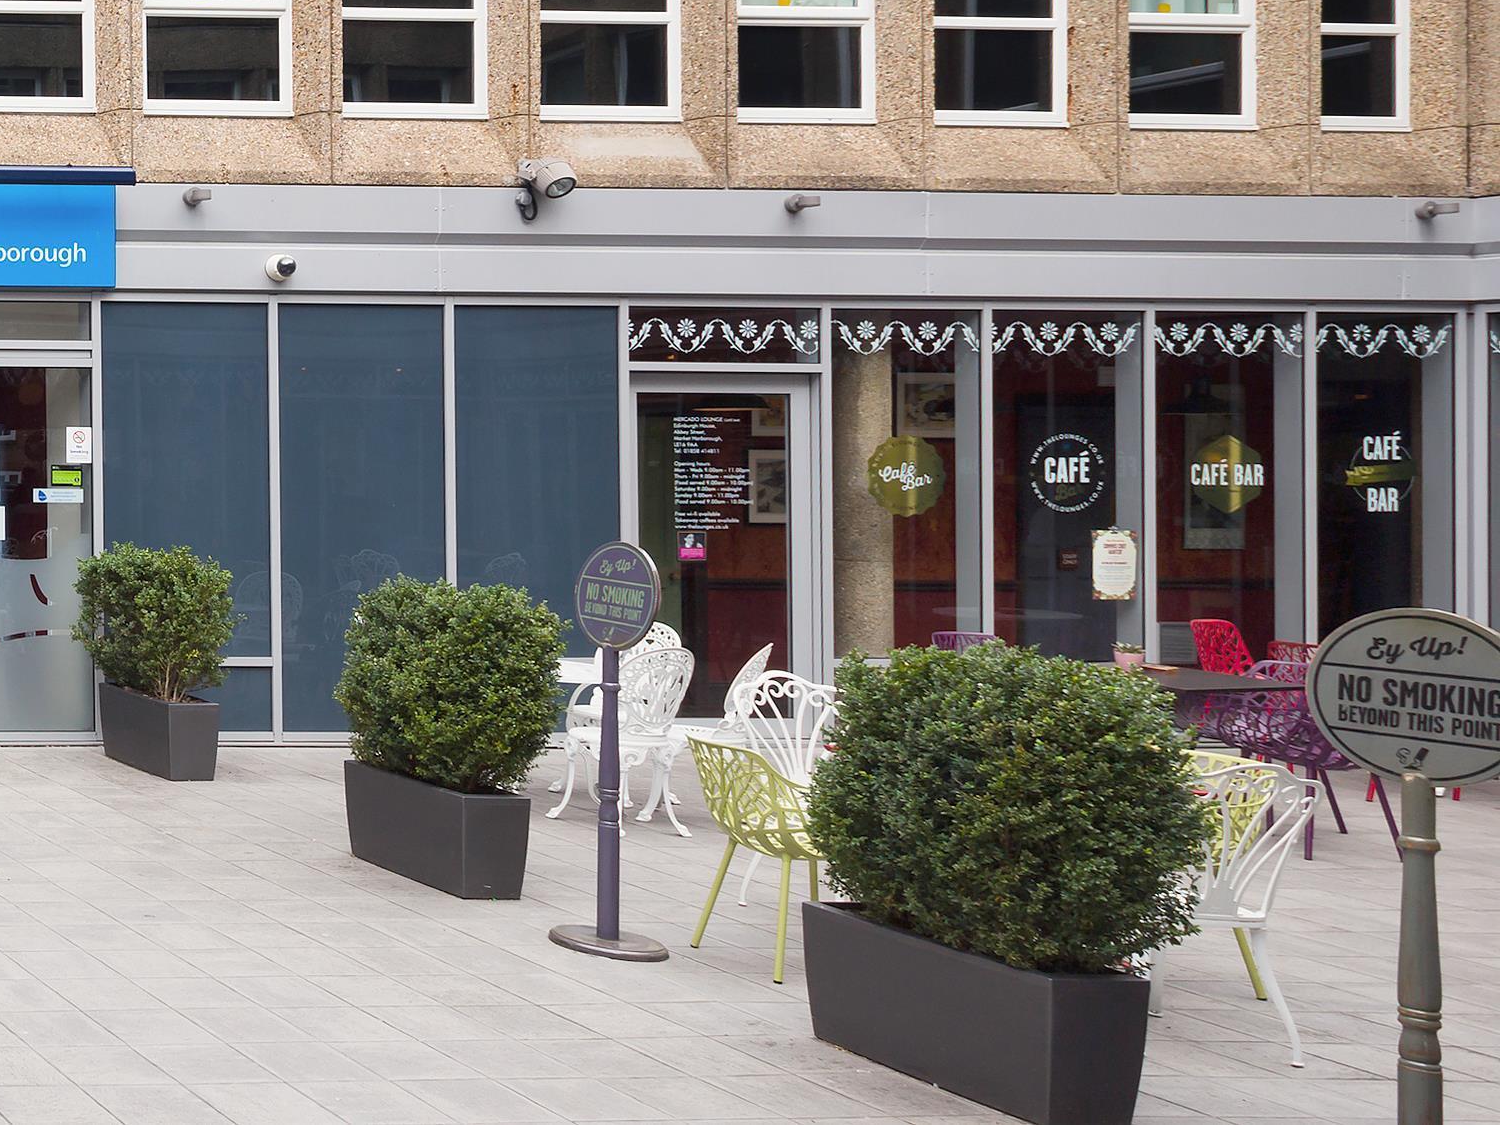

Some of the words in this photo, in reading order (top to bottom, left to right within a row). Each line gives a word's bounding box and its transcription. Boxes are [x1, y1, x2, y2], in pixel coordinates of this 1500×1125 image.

[1363, 431, 1402, 461] CAFÉ
[878, 462, 916, 484] Café
[1044, 450, 1090, 484] CAFÉ
[1191, 459, 1228, 486] CAFÉ
[1234, 463, 1264, 486] BAR
[901, 474, 933, 492] Bar
[1367, 488, 1399, 512] BAR
[599, 559, 614, 576] Ey
[615, 558, 637, 573] Up!
[586, 582, 600, 601] NO
[601, 585, 645, 609] SMOKING
[584, 601, 607, 616] BEYOND
[609, 605, 622, 618] THIS
[623, 608, 642, 622] POINT
[1367, 637, 1404, 664] Ey
[1409, 636, 1468, 660] Up!
[1338, 673, 1372, 703] NO
[1382, 678, 1500, 719] SMOKING
[1338, 704, 1400, 728] BEYOND
[1407, 712, 1444, 735] THIS
